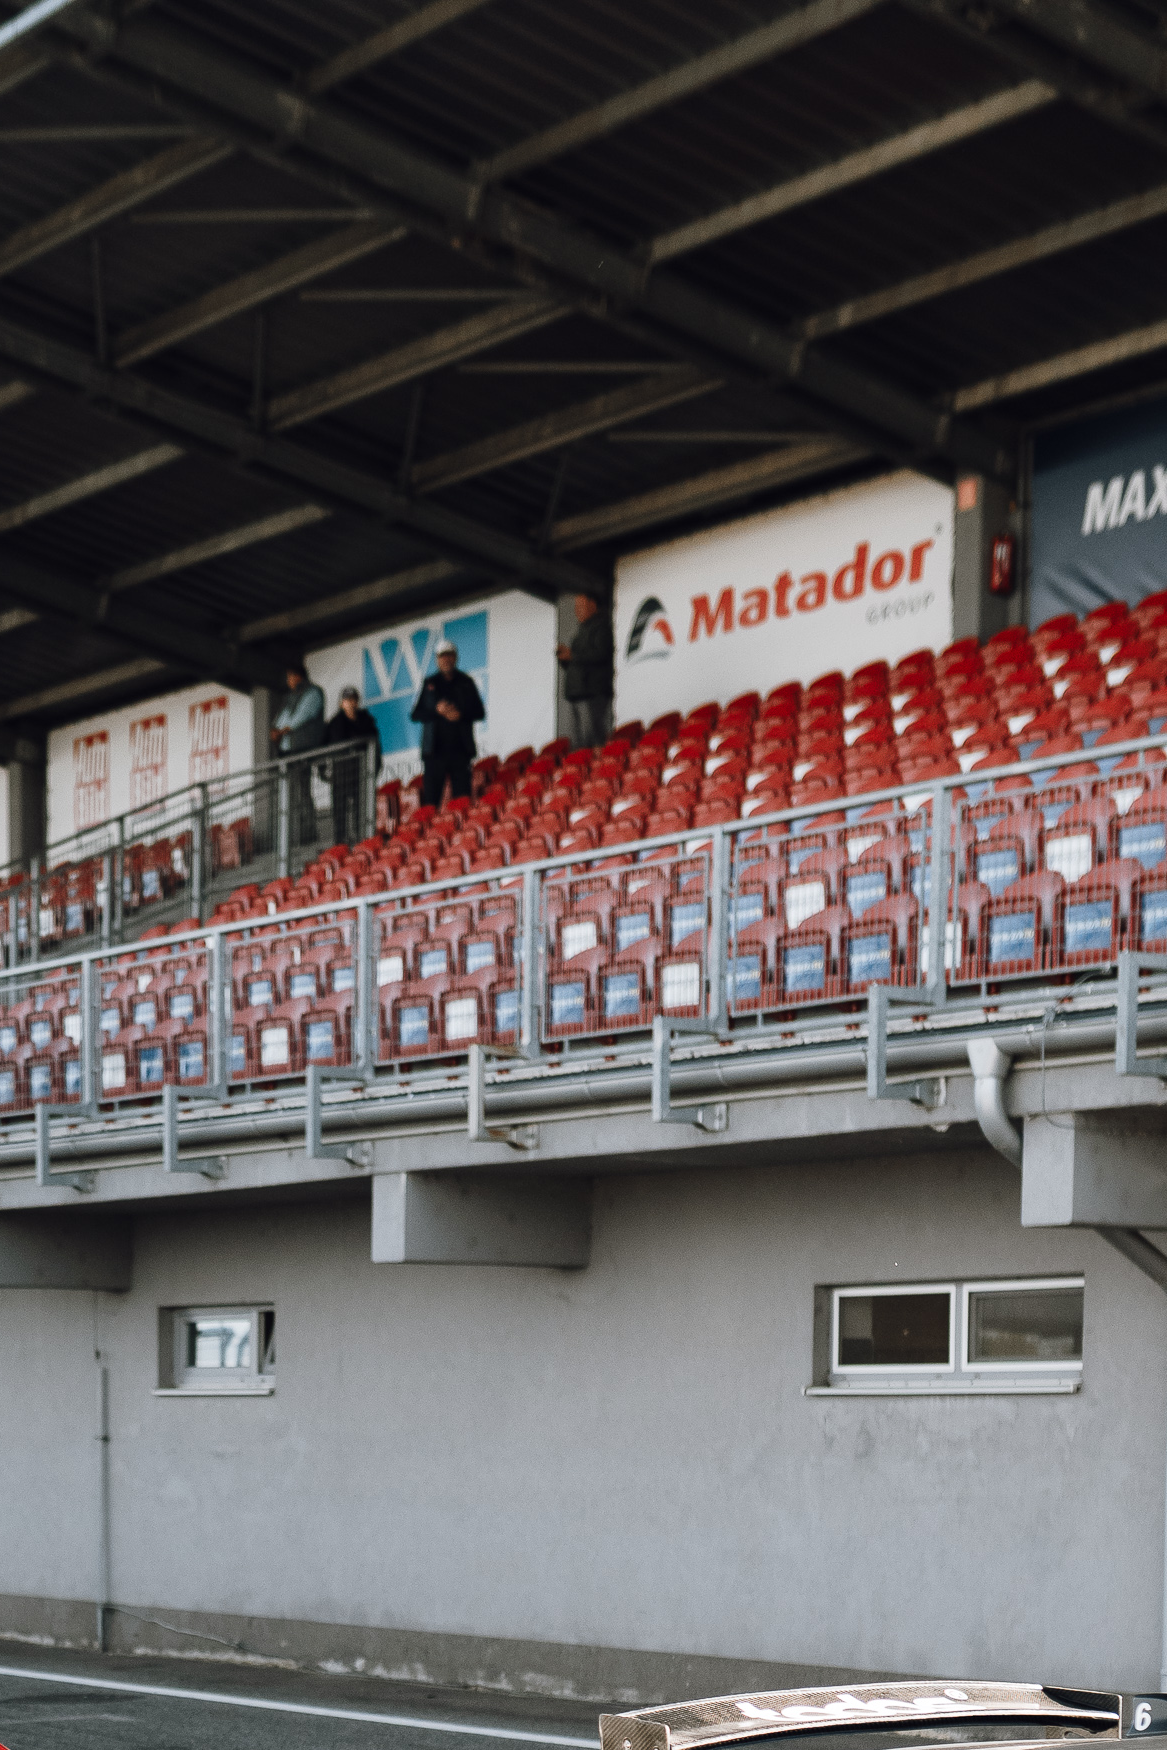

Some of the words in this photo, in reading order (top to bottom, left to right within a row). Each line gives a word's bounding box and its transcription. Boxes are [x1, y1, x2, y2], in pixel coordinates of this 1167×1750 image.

[1081, 464, 1167, 536] MAX
[688, 537, 934, 645] Matador
[1135, 1702, 1152, 1731] 6
